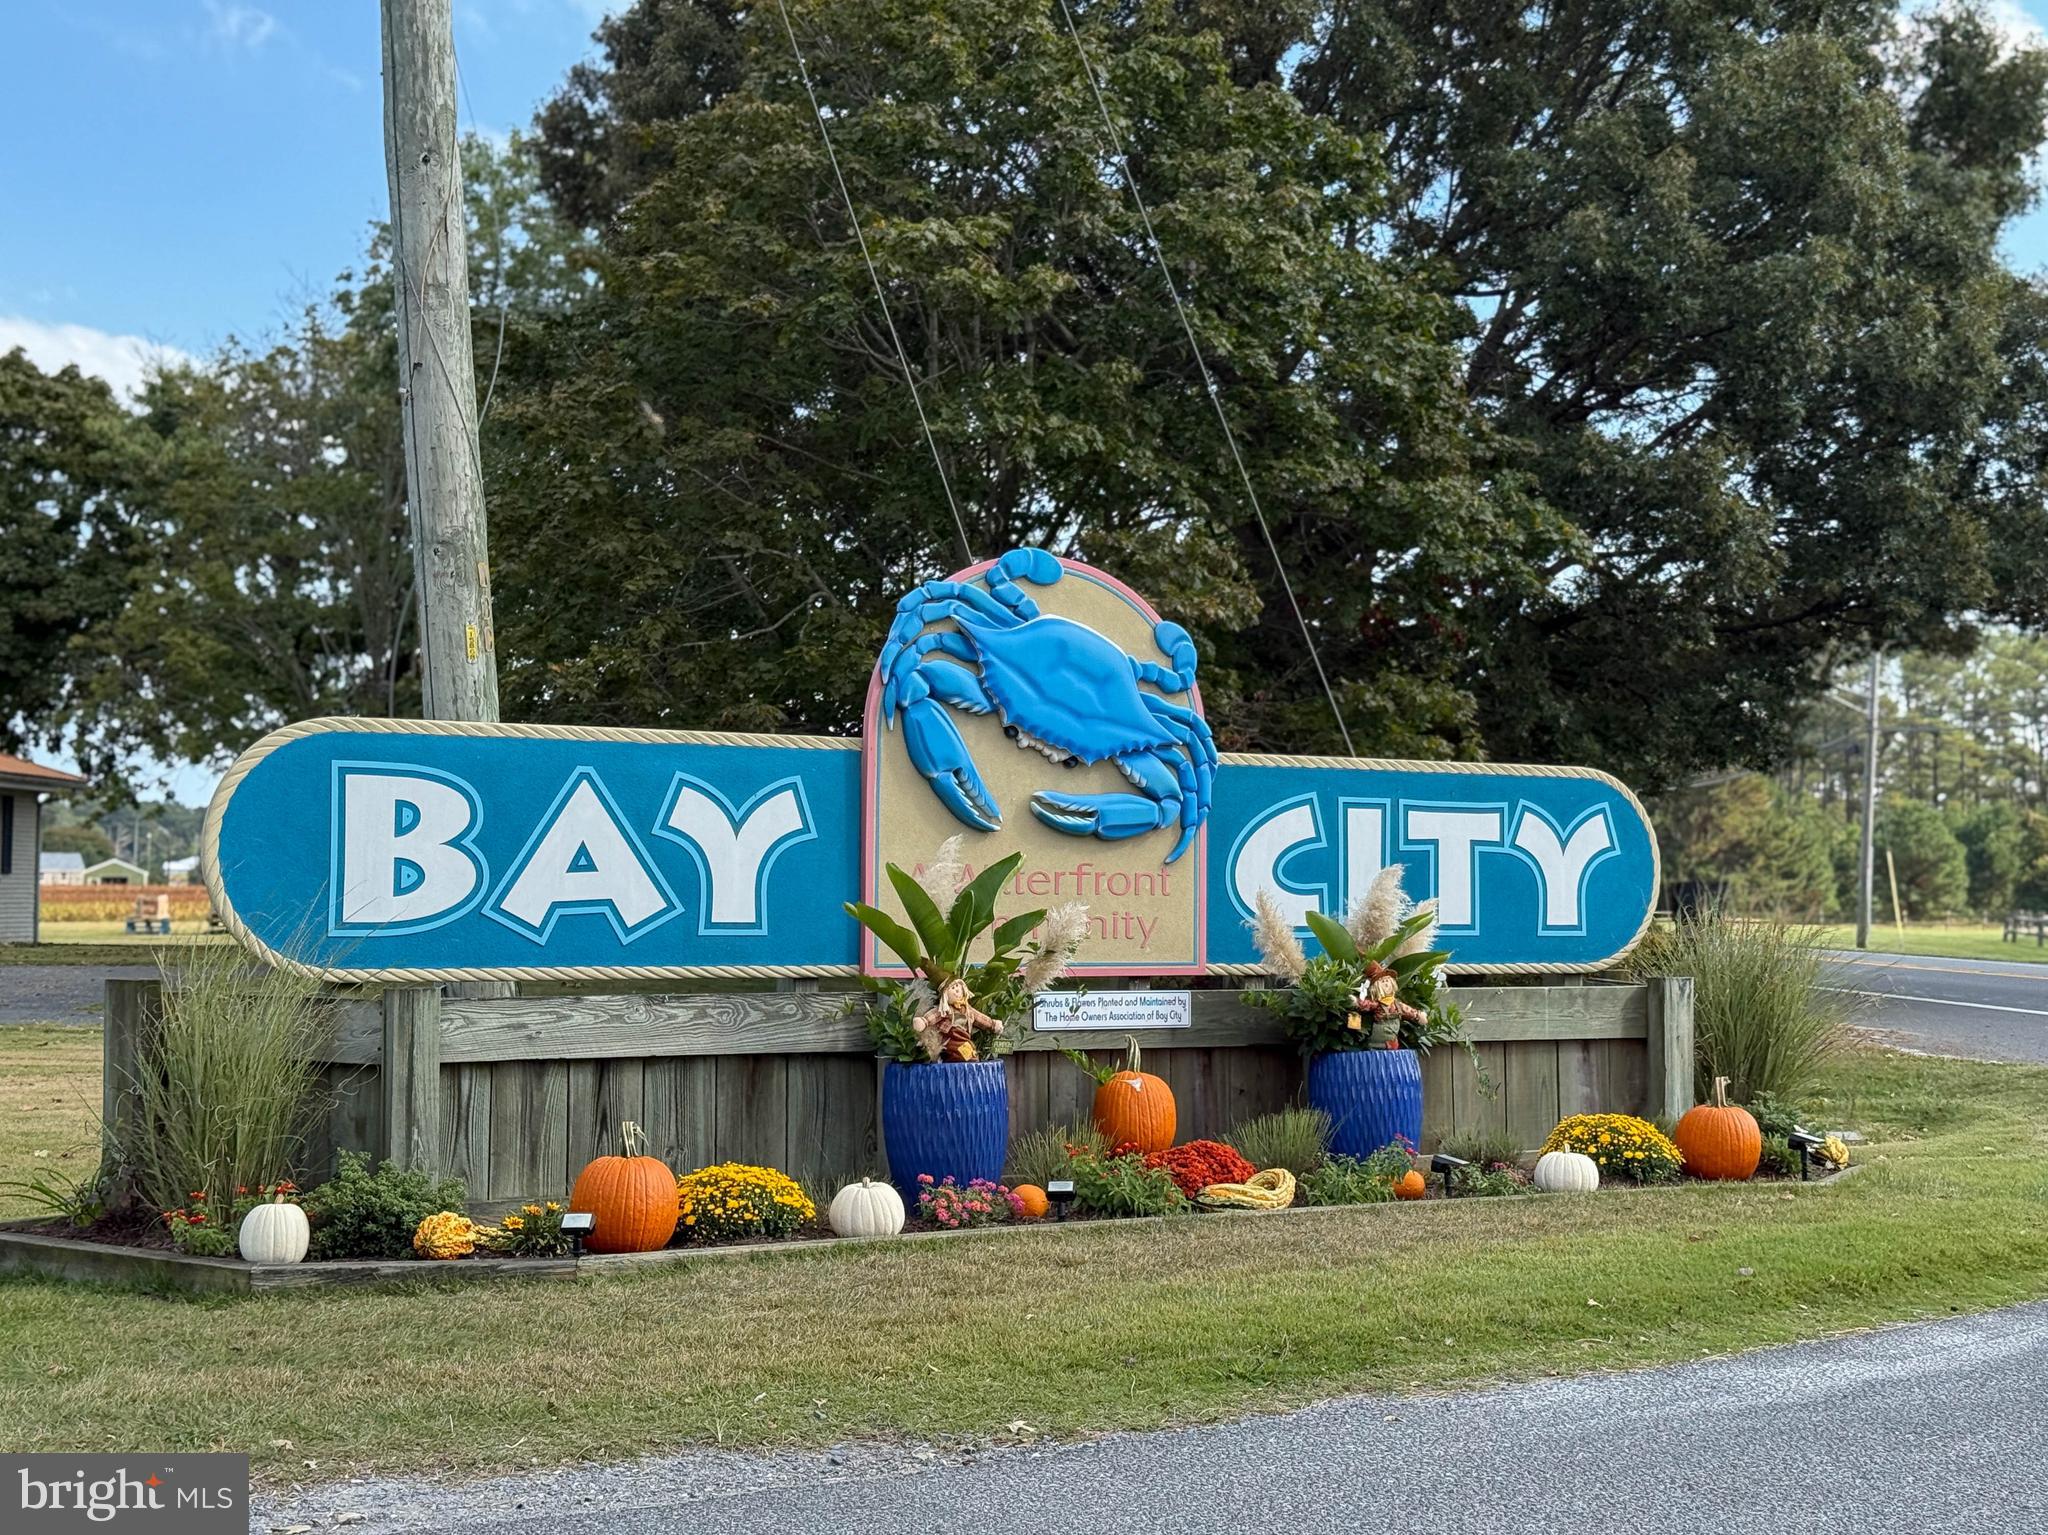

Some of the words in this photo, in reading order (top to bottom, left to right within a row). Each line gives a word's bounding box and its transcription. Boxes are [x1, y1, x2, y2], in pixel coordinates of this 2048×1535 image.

[328, 759, 818, 946] BAY
[1226, 792, 1621, 937] CITY
[953, 863, 1171, 896] terfront
[1065, 997, 1070, 1007] &
[1098, 996, 1123, 1007] Planted
[1125, 996, 1138, 1006] and
[1140, 996, 1177, 1006] Maintained
[1178, 996, 1187, 1008] by
[1045, 1011, 1058, 1022] The
[1081, 1011, 1107, 1021] Owners
[1109, 1010, 1146, 1020] Association
[1147, 1010, 1154, 1020] of
[1156, 1010, 1168, 1023] Bay
[1170, 1009, 1182, 1023] City
